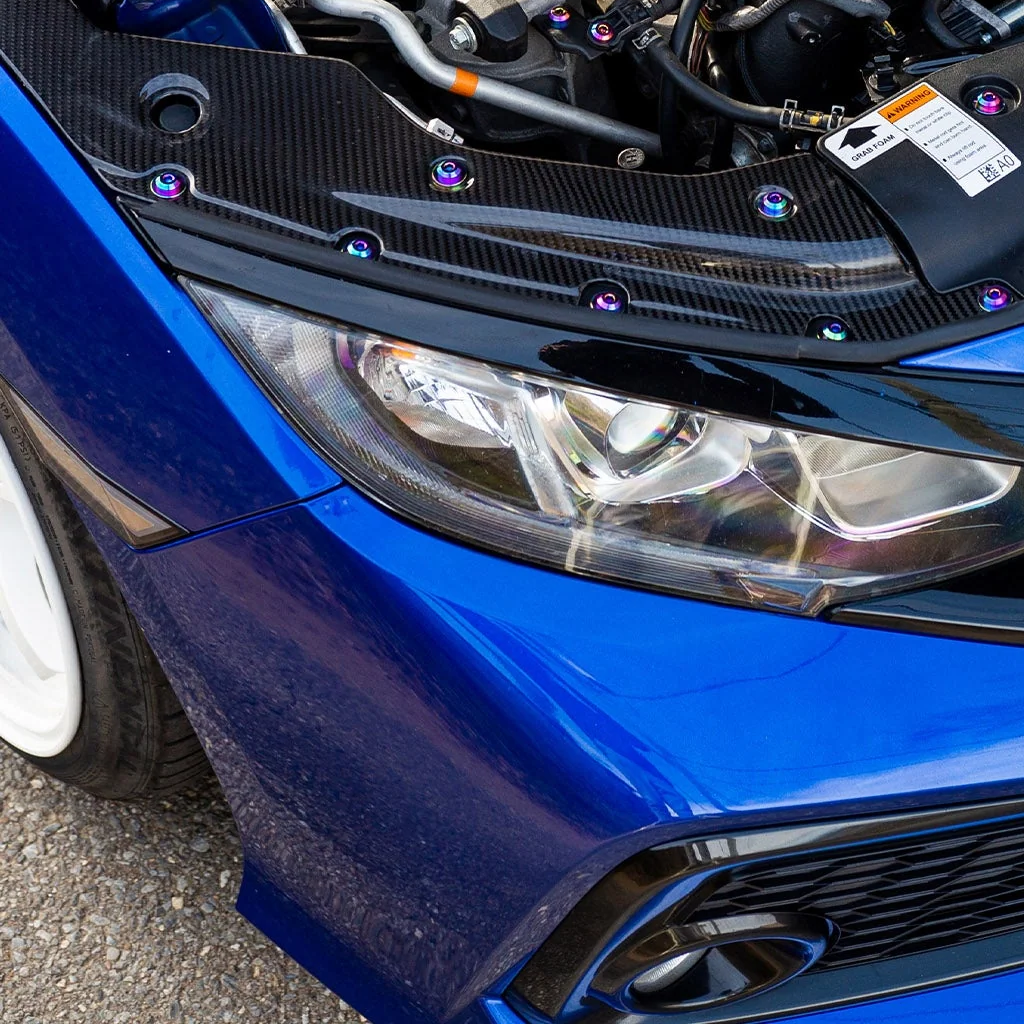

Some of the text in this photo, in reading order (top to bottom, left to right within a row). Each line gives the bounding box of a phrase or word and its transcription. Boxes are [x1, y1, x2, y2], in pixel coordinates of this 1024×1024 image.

[893, 89, 931, 114] WARNING
[851, 134, 896, 162] GRAB FOAM
